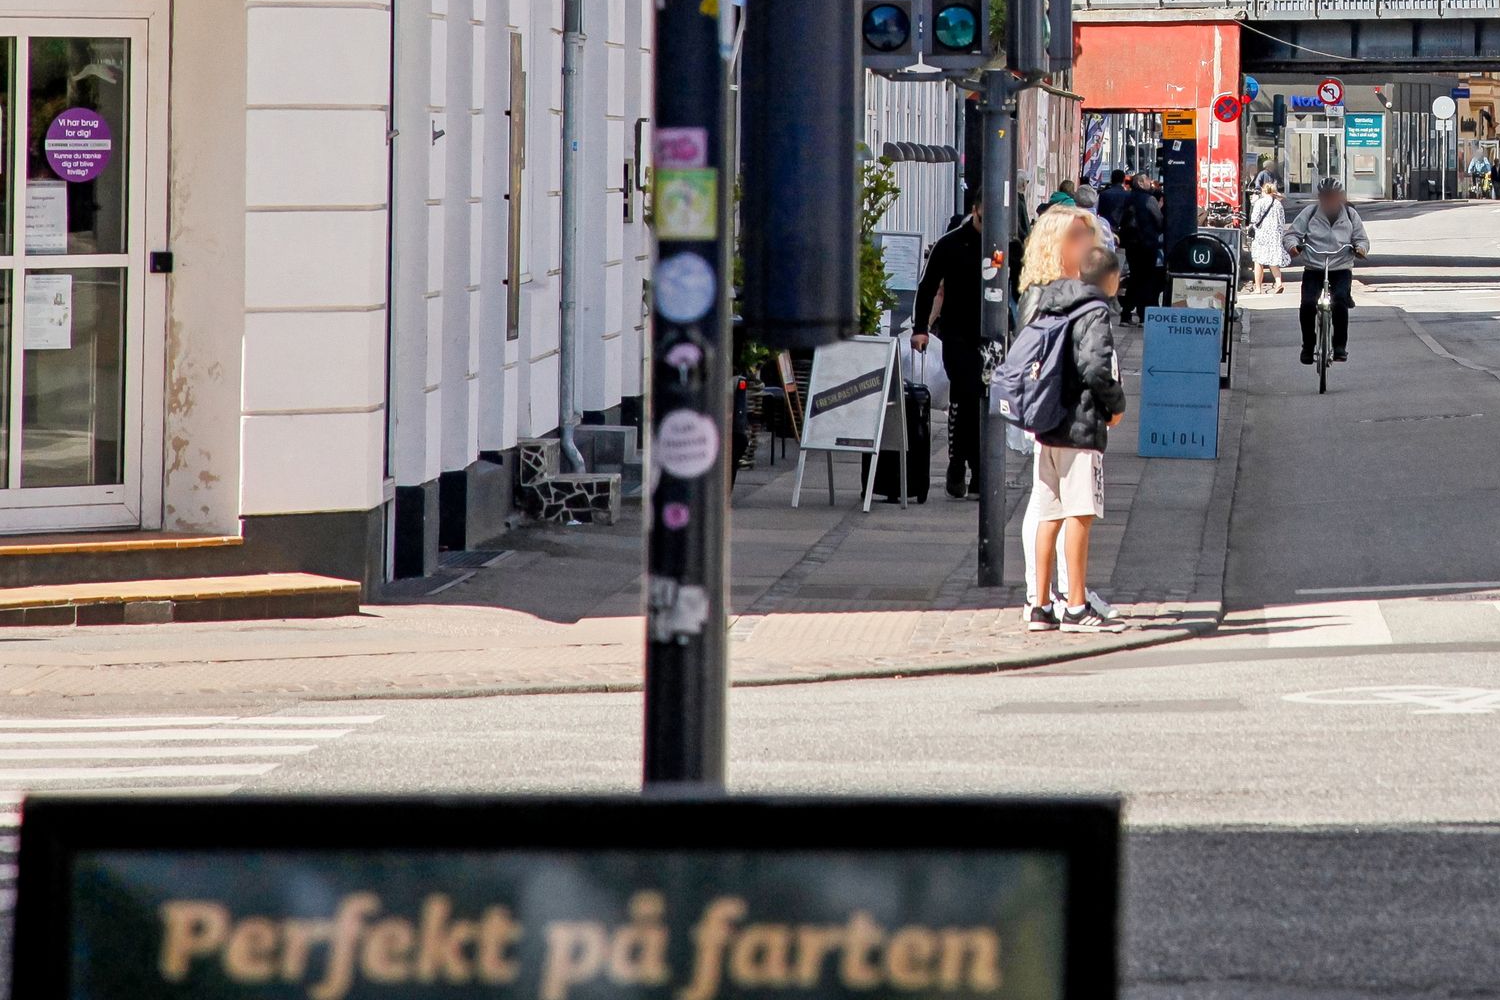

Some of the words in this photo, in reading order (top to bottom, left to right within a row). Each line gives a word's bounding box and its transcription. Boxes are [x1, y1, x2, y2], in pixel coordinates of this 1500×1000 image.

[81, 118, 98, 128] brug
[65, 129, 75, 137] for
[1180, 315, 1220, 325] BOWLS
[1168, 325, 1193, 335] THIS
[1195, 327, 1218, 336] WAY
[837, 385, 858, 400] PASTA
[858, 376, 880, 391] INSIDE
[160, 891, 520, 1000] Perfekt
[539, 890, 670, 1000] på
[682, 895, 997, 1000] farten
